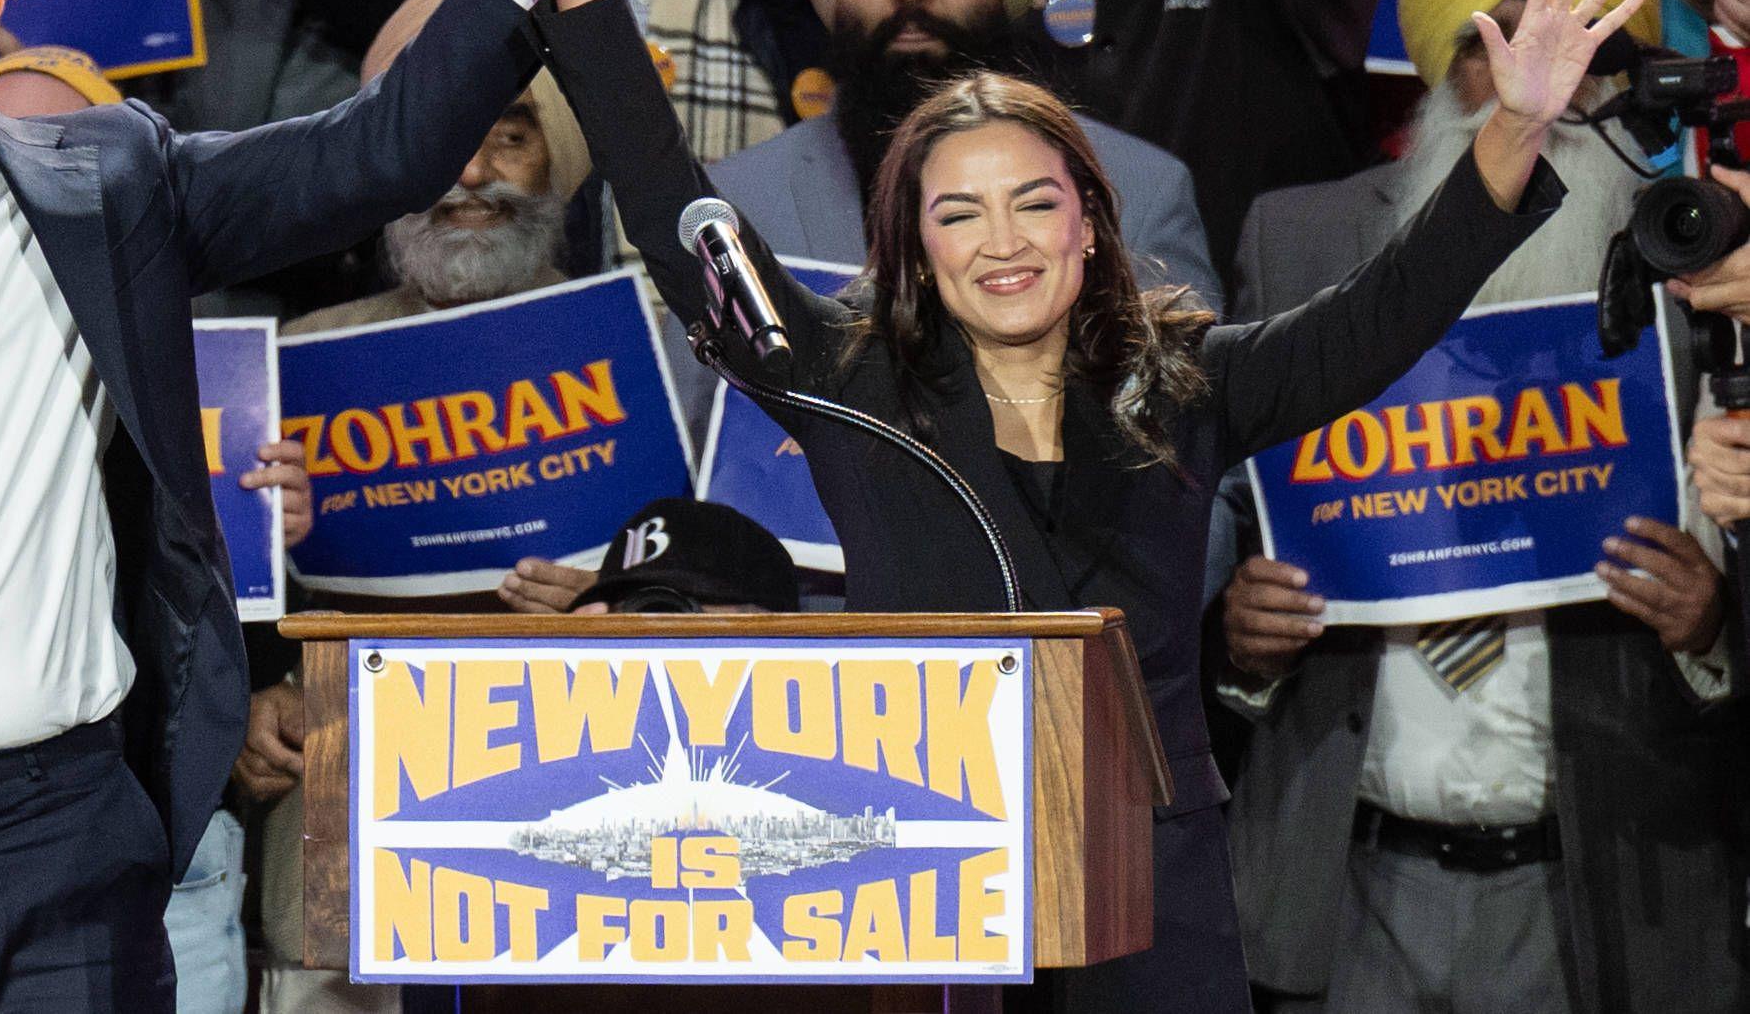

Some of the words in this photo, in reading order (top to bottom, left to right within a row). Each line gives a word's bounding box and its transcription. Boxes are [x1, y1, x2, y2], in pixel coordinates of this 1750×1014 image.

[282, 360, 626, 478] ZOHRAN
[1289, 377, 1629, 486] ZOHRAN
[321, 488, 357, 516] FOR
[362, 475, 437, 510] NEW
[441, 462, 534, 500] YORK
[539, 438, 618, 482] CITY
[1311, 498, 1345, 526] FOR
[1350, 486, 1430, 521] NEW
[1434, 473, 1530, 511] YORK
[1533, 462, 1616, 496] CITY
[1388, 536, 1536, 568] ZOHRANFORNYC.COM
[373, 658, 651, 823] NEW
[662, 658, 1010, 823] YORK
[373, 846, 550, 963] NOT
[575, 891, 753, 963] FOR
[782, 846, 1010, 963] SALE
[650, 835, 742, 890] IS
